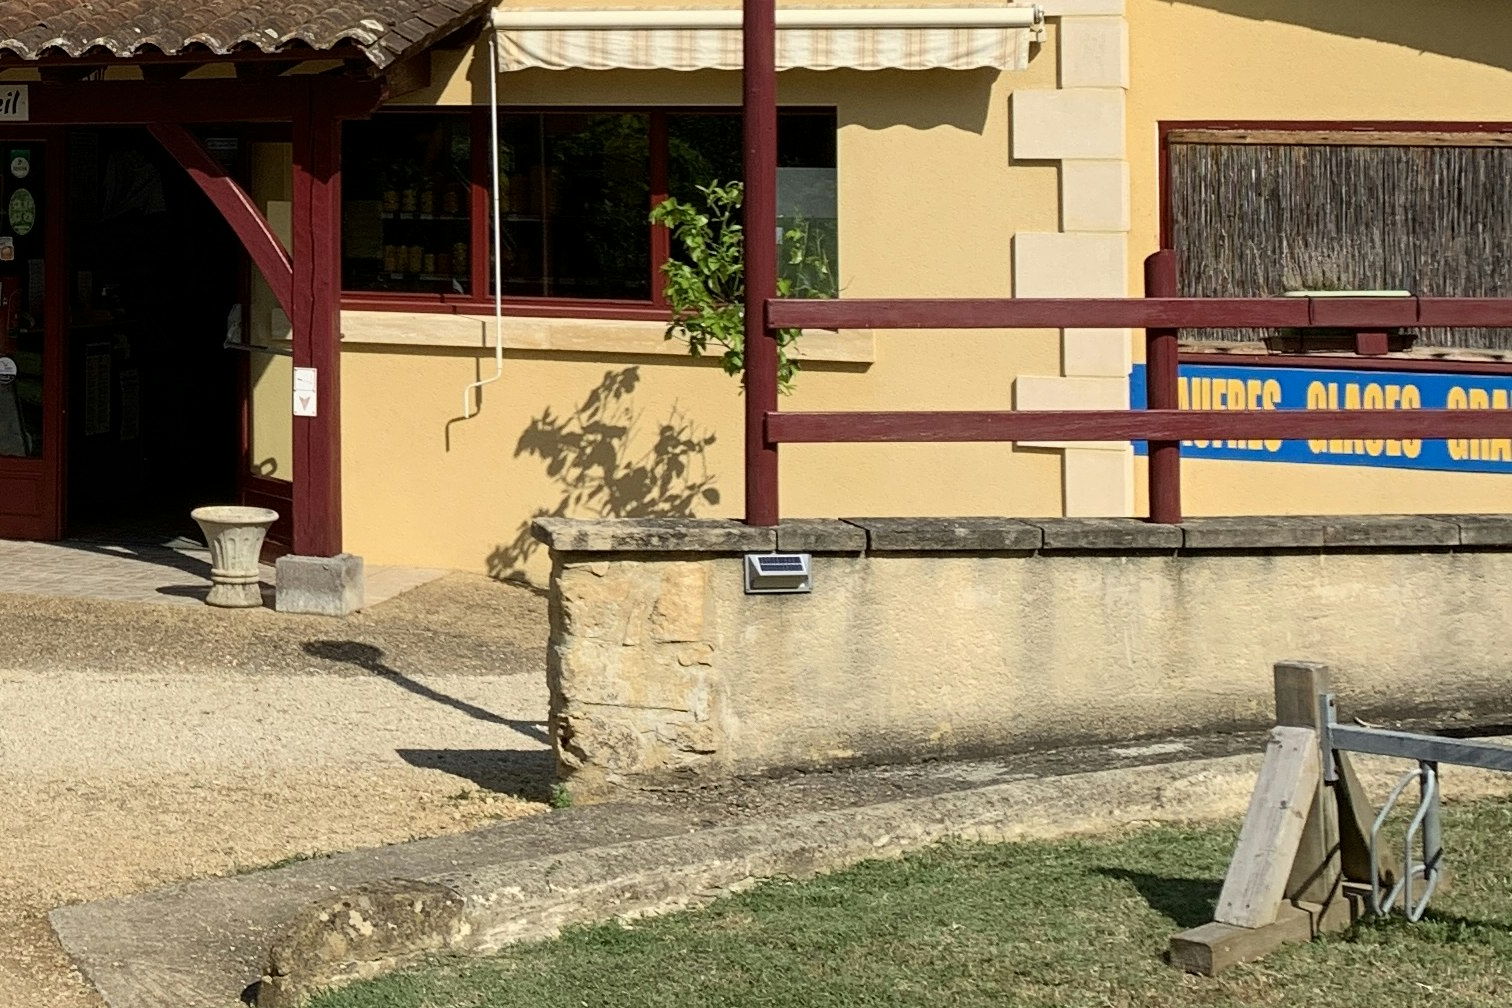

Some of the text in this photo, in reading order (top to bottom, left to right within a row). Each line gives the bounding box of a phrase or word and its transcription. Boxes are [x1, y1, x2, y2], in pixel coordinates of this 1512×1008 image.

[1178, 377, 1512, 463] UFRES GLACES GRA
